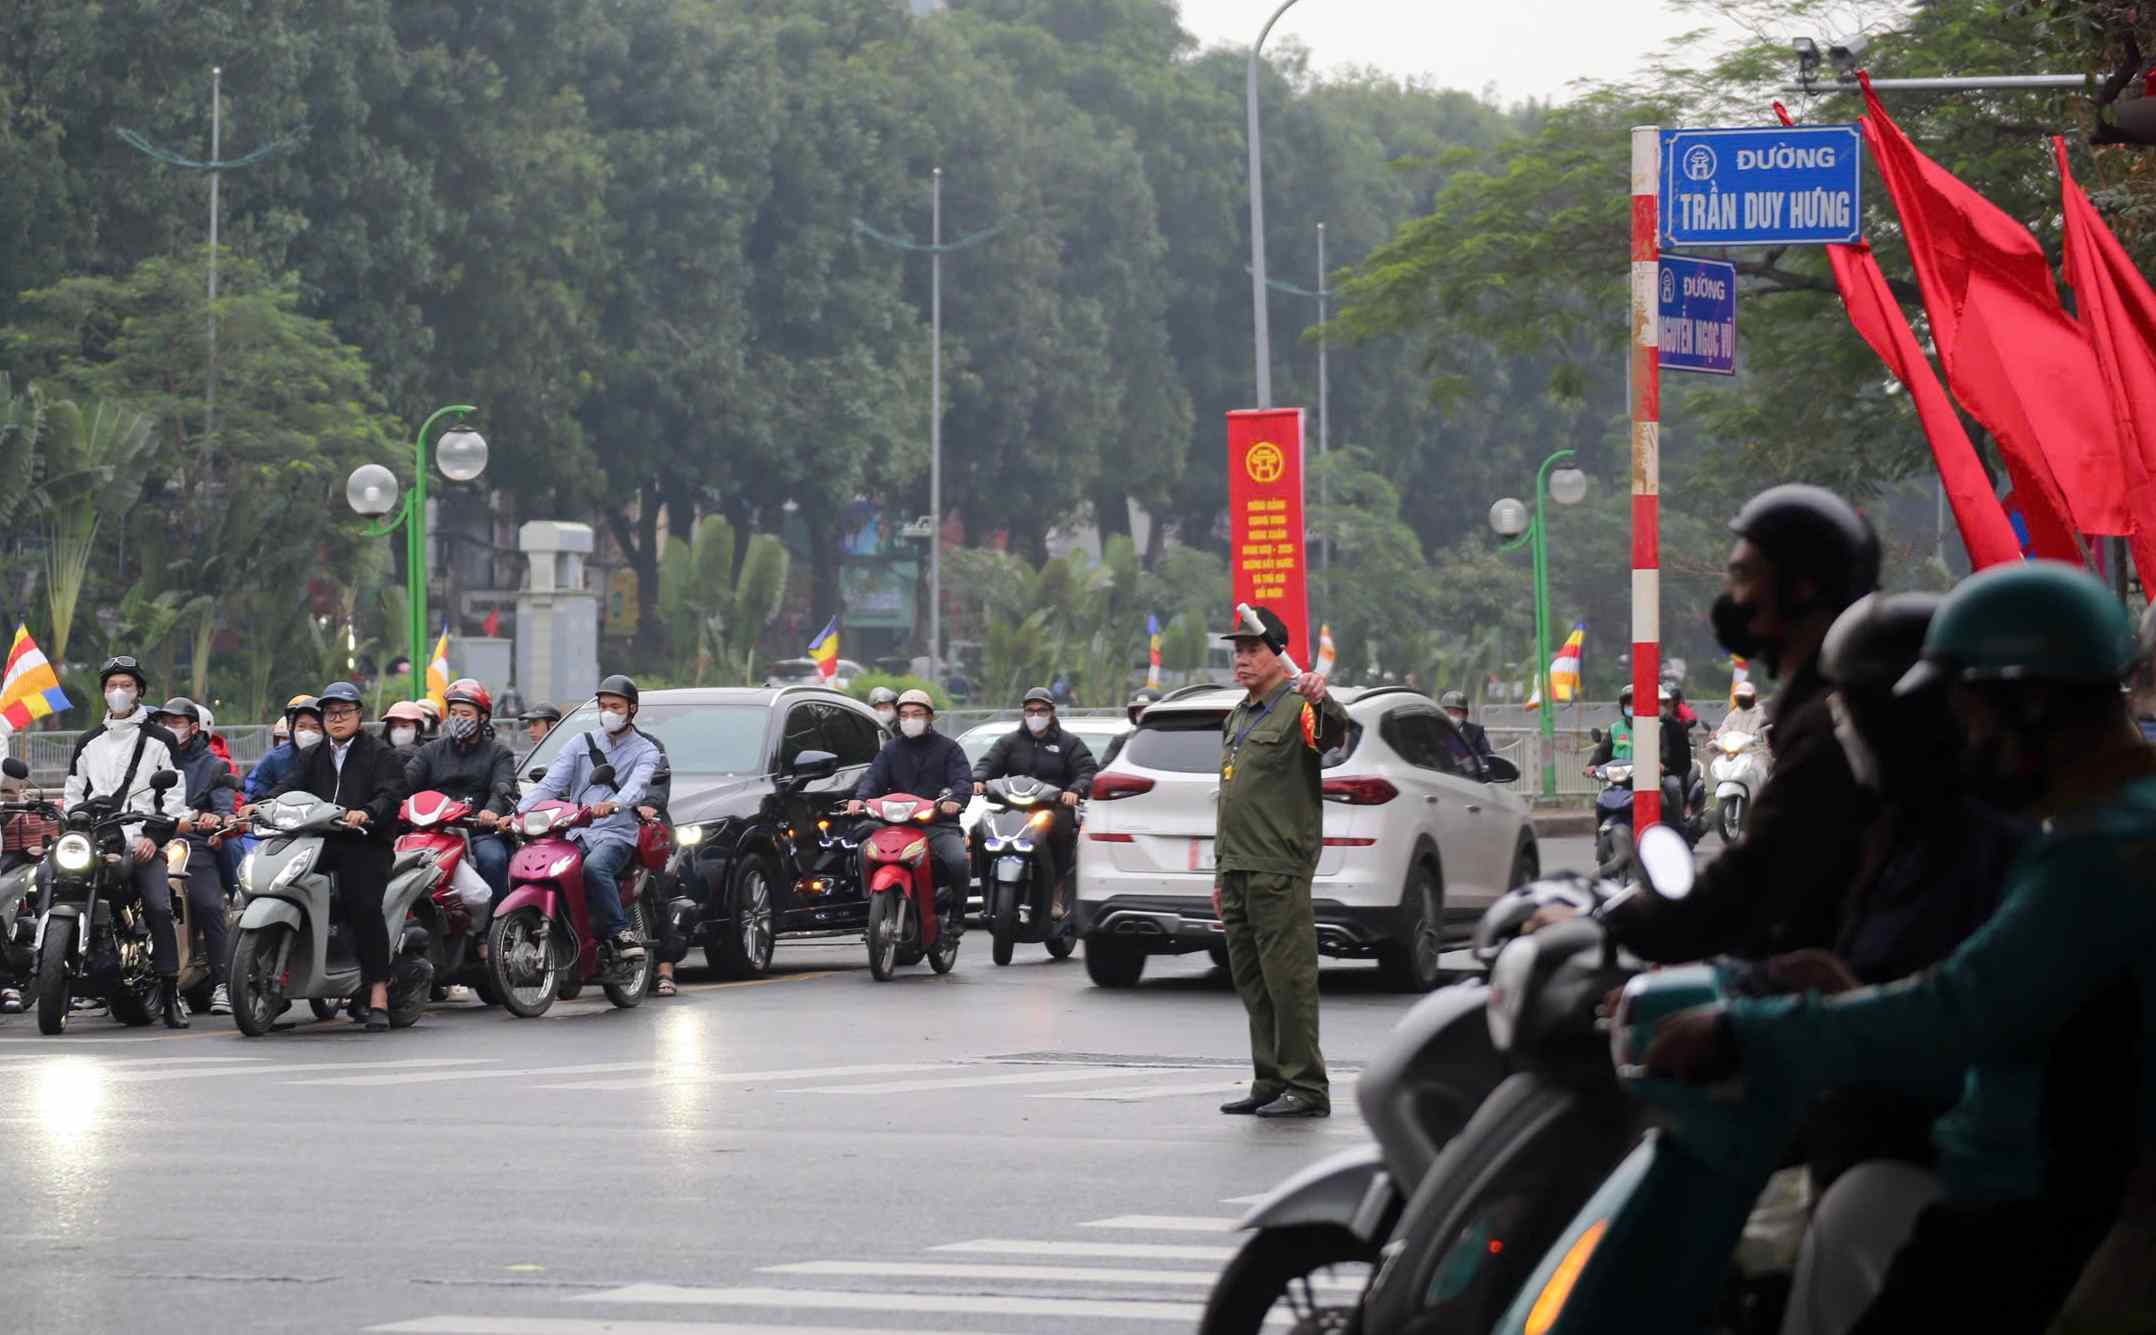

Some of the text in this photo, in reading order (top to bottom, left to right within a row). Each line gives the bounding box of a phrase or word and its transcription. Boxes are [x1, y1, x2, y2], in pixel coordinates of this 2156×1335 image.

[1736, 142, 1836, 171] ĐƯỜNG
[1680, 179, 1850, 231] TRẦN DUY HƯNG
[1683, 271, 1726, 300] ĐƯỜNG
